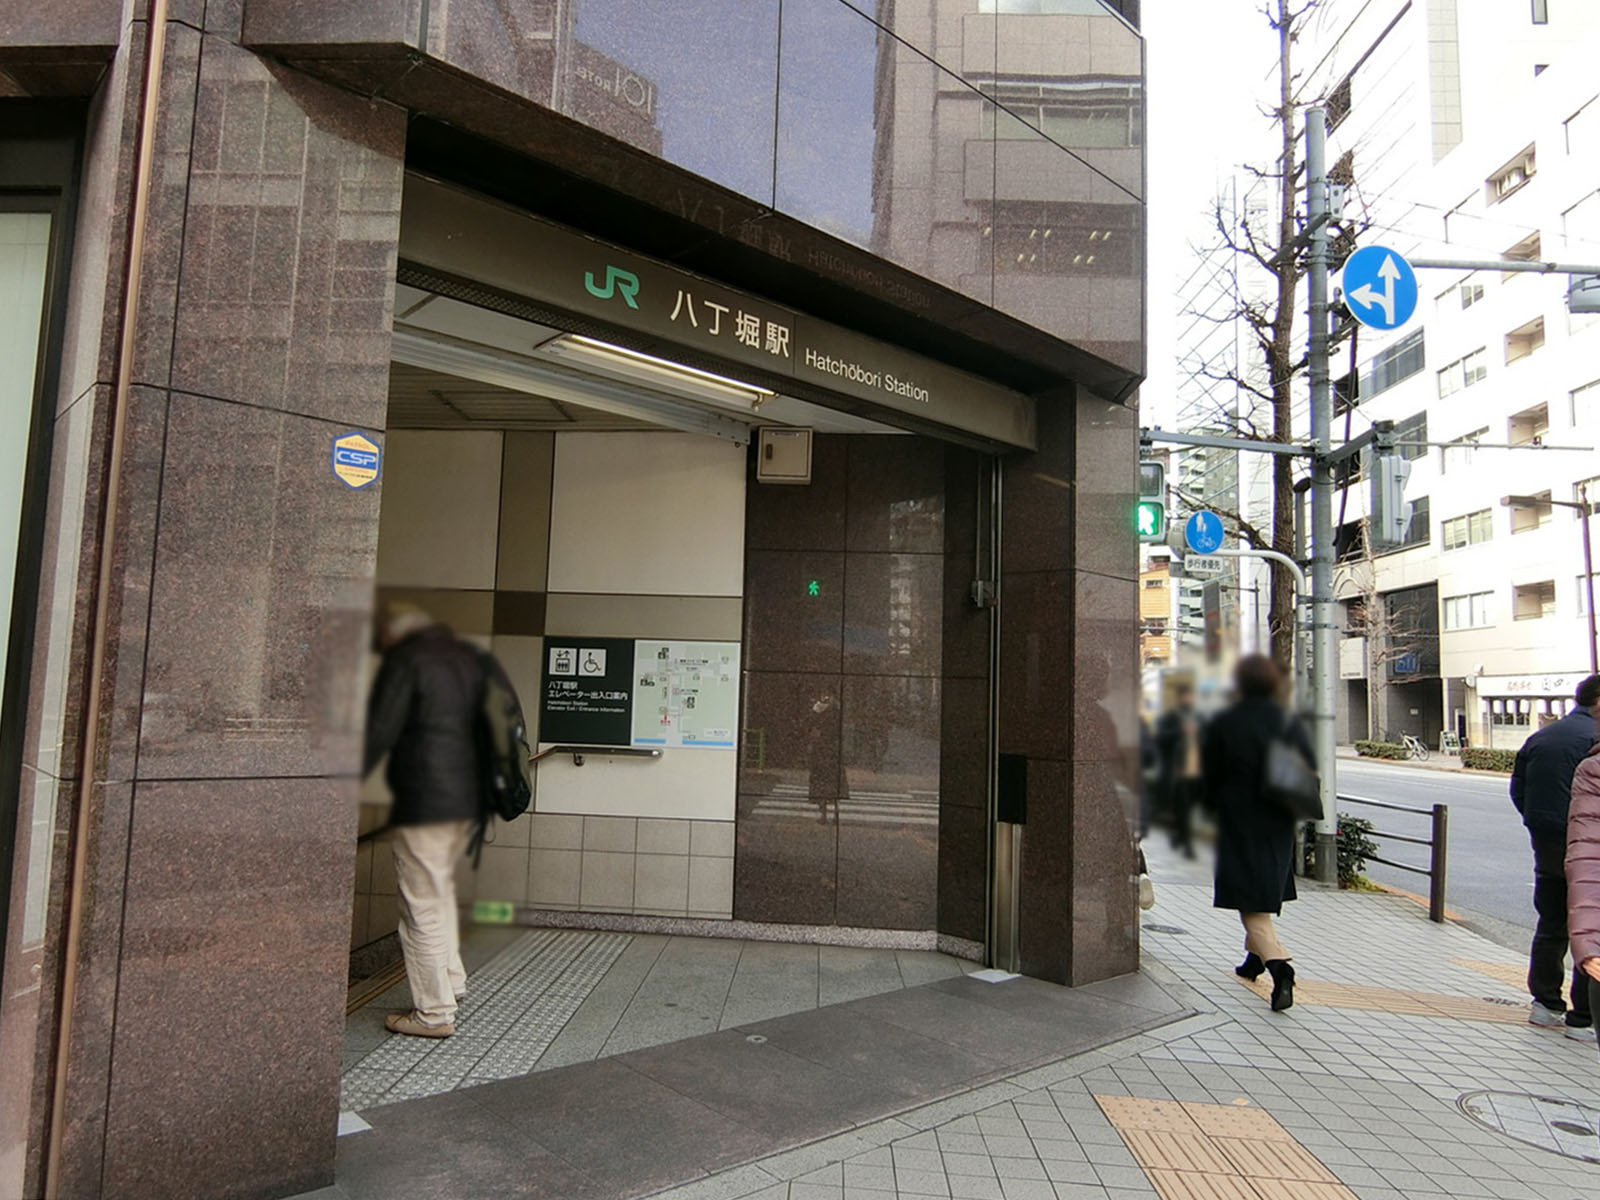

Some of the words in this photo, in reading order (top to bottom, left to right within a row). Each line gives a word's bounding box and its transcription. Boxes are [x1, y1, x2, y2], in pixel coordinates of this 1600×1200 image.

[585, 265, 640, 310] JR
[669, 290, 790, 358] 八丁堀駅
[884, 374, 929, 403] Station
[337, 450, 377, 466] CSP
